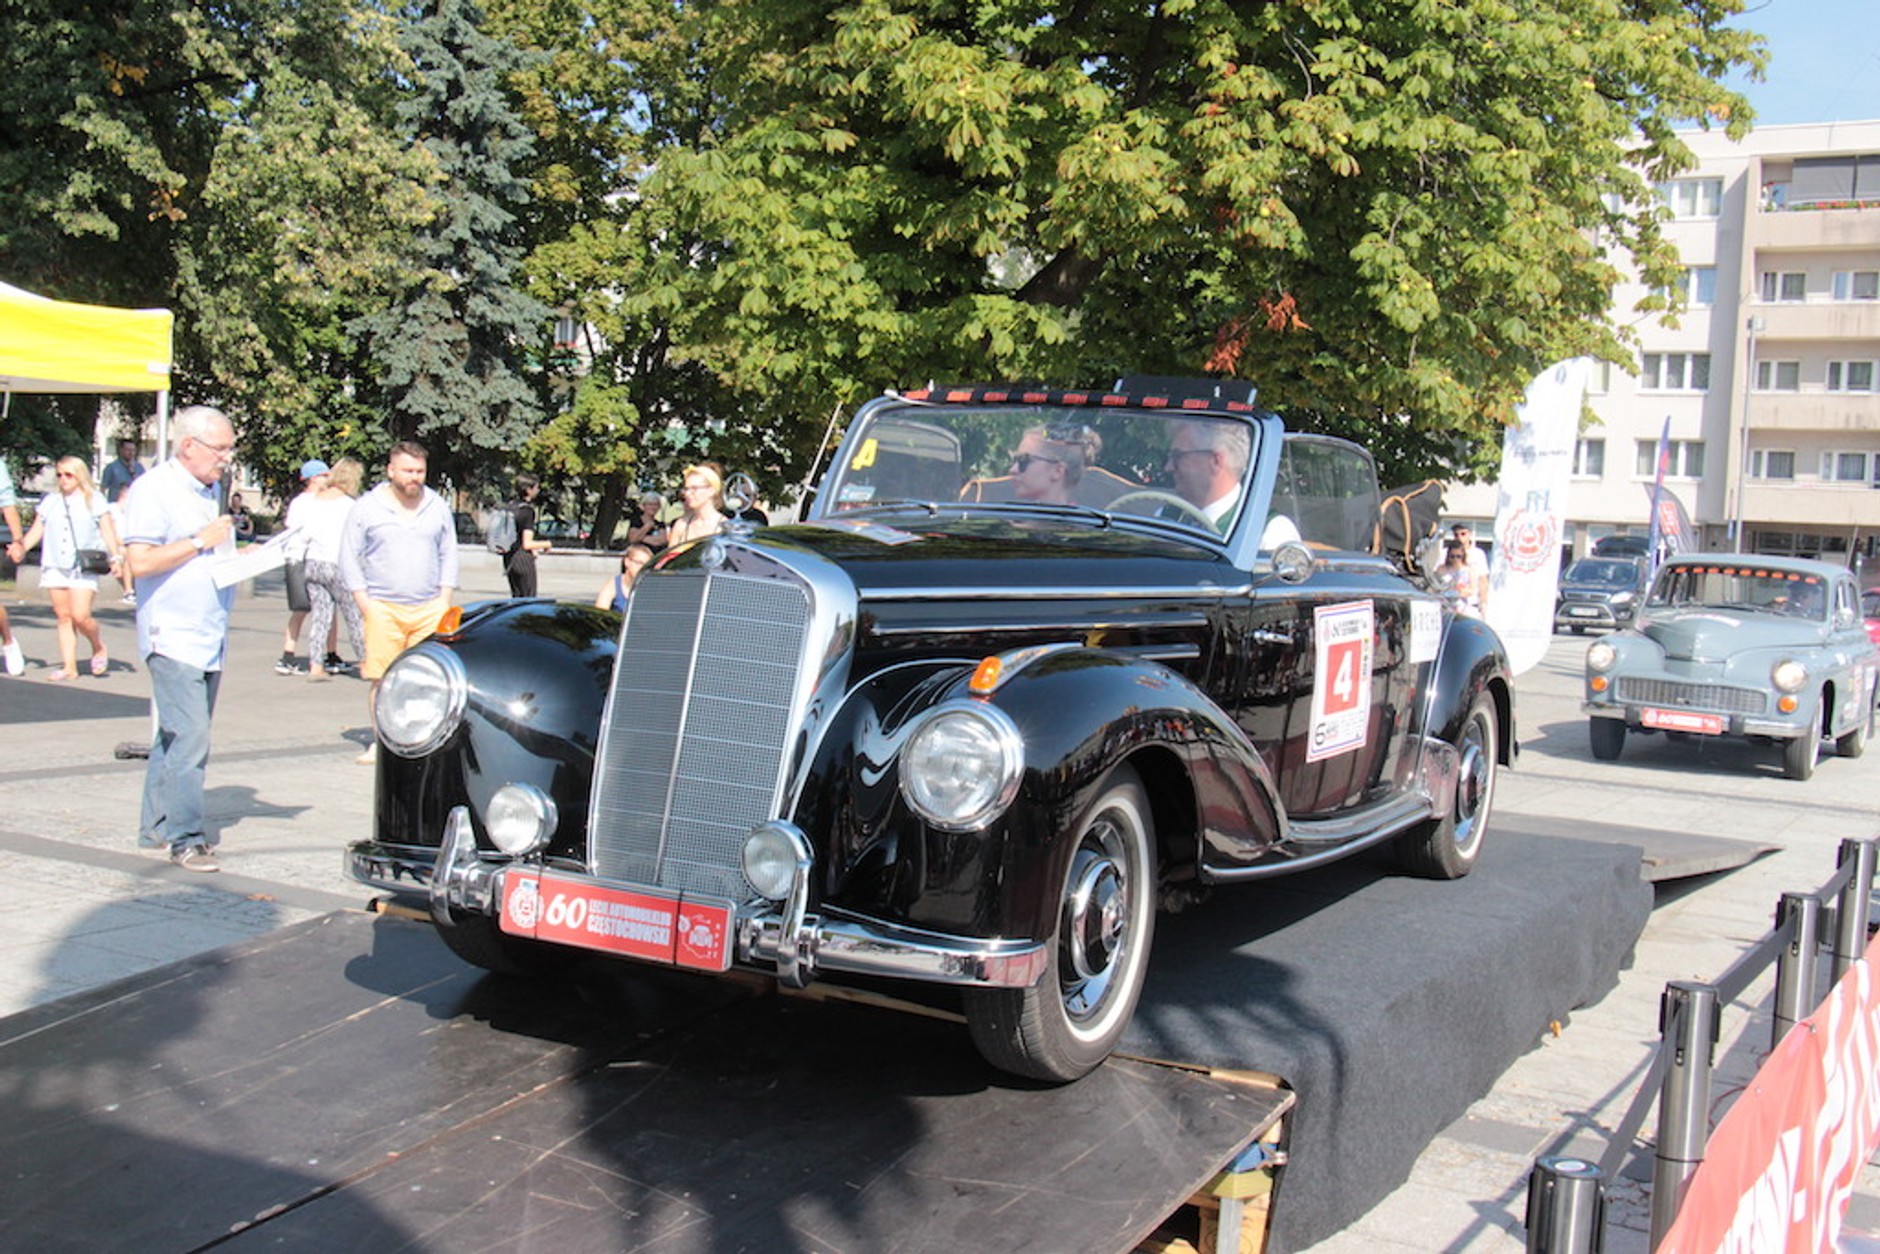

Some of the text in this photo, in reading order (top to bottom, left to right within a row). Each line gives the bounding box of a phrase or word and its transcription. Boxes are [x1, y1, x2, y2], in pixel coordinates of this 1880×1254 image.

[851, 438, 878, 471] 4
[1333, 650, 1353, 703] 4
[545, 893, 587, 929] 60
